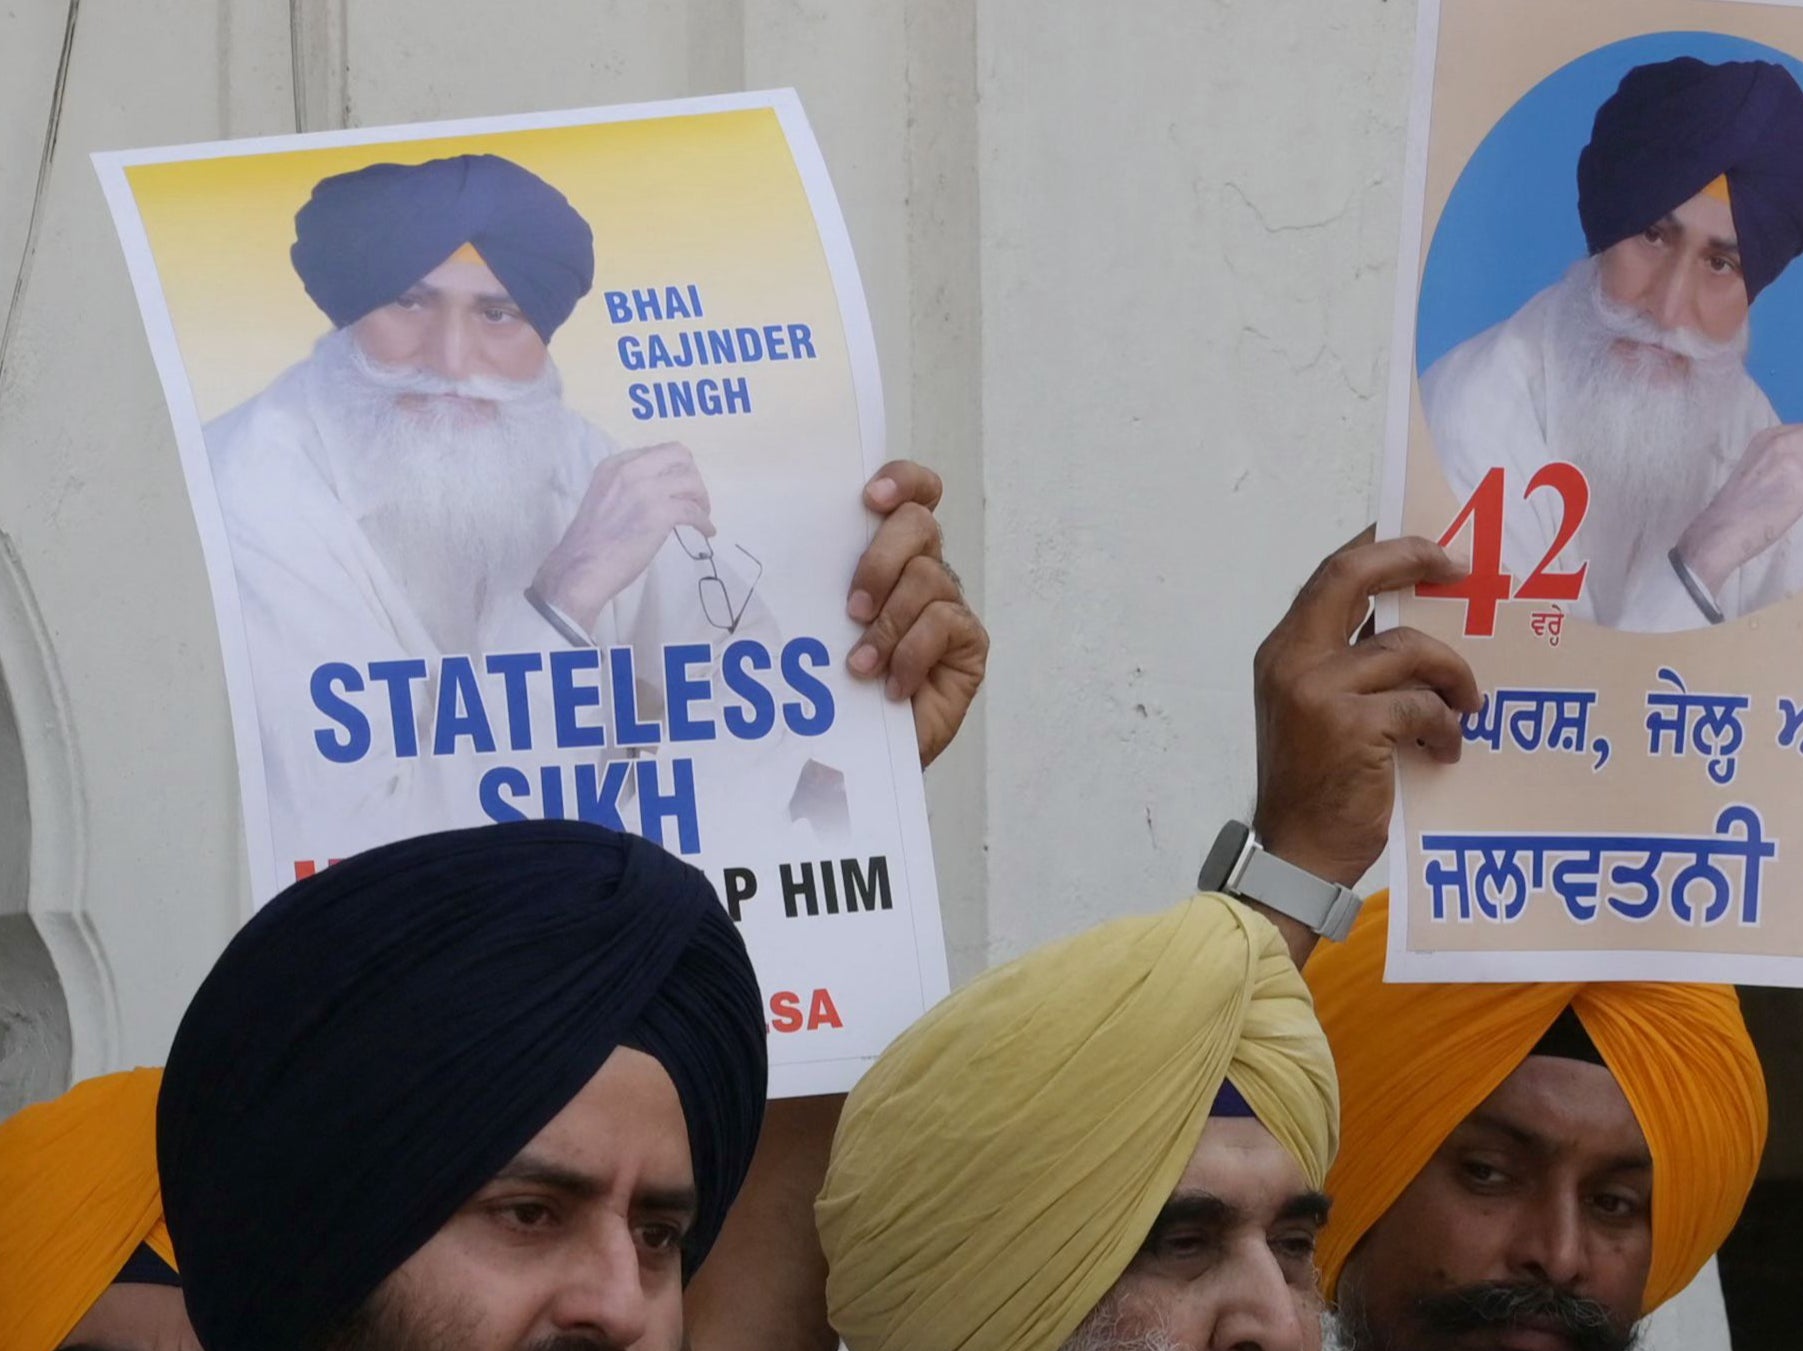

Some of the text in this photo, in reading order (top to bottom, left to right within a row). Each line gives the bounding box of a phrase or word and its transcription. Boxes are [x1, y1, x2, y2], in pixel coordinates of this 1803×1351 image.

[604, 285, 703, 324] BHAI
[617, 323, 816, 371] GAJINDER
[628, 377, 751, 420] SINGH
[1415, 462, 1589, 637] 42
[309, 636, 835, 763] STATELESS
[480, 758, 700, 854] SIKH
[780, 856, 893, 918] HIM
[1421, 807, 1775, 926] ਜਲਾਵਤਨੀ
